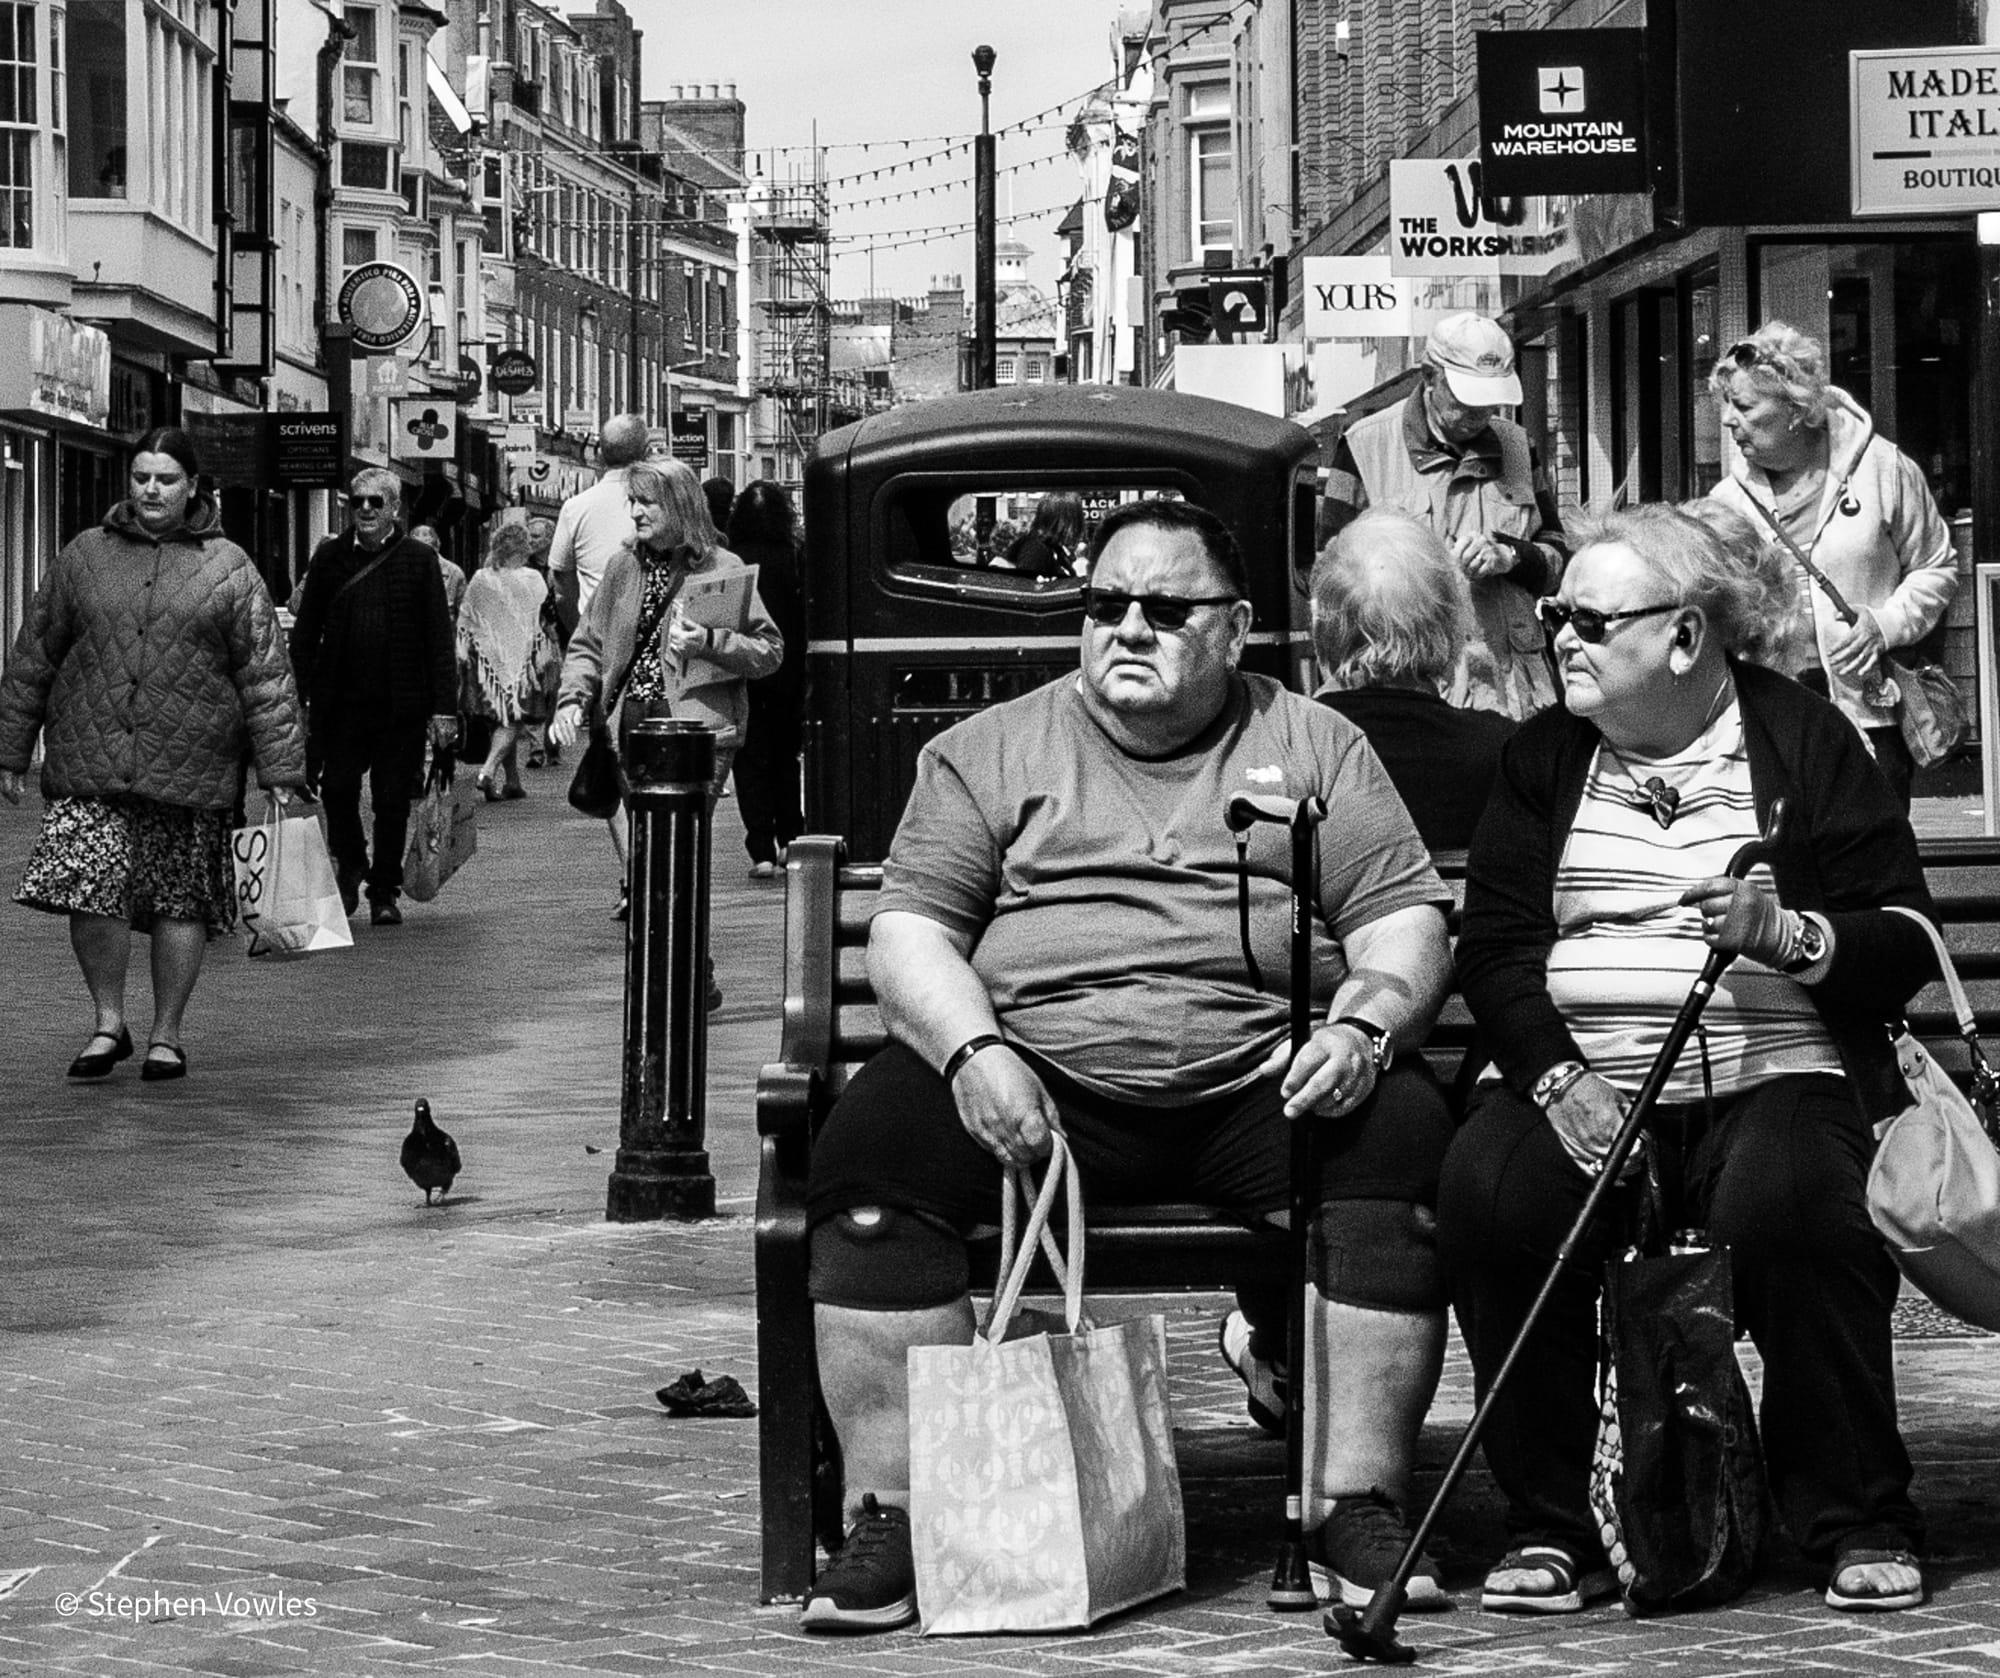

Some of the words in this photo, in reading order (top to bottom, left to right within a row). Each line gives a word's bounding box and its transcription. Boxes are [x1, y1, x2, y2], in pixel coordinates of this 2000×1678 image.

[1887, 67, 1999, 100] MADE
[1503, 121, 1624, 139] MOUNTAIN
[1908, 108, 2000, 139] ITAL
[1491, 138, 1638, 156] WAREHOUSE
[1399, 217, 1438, 234] THE
[1399, 236, 1499, 258] WORKS
[1312, 283, 1397, 311] YOURS
[279, 420, 337, 436] scrivens
[671, 433, 705, 443] uction
[1081, 498, 1118, 509] LACK
